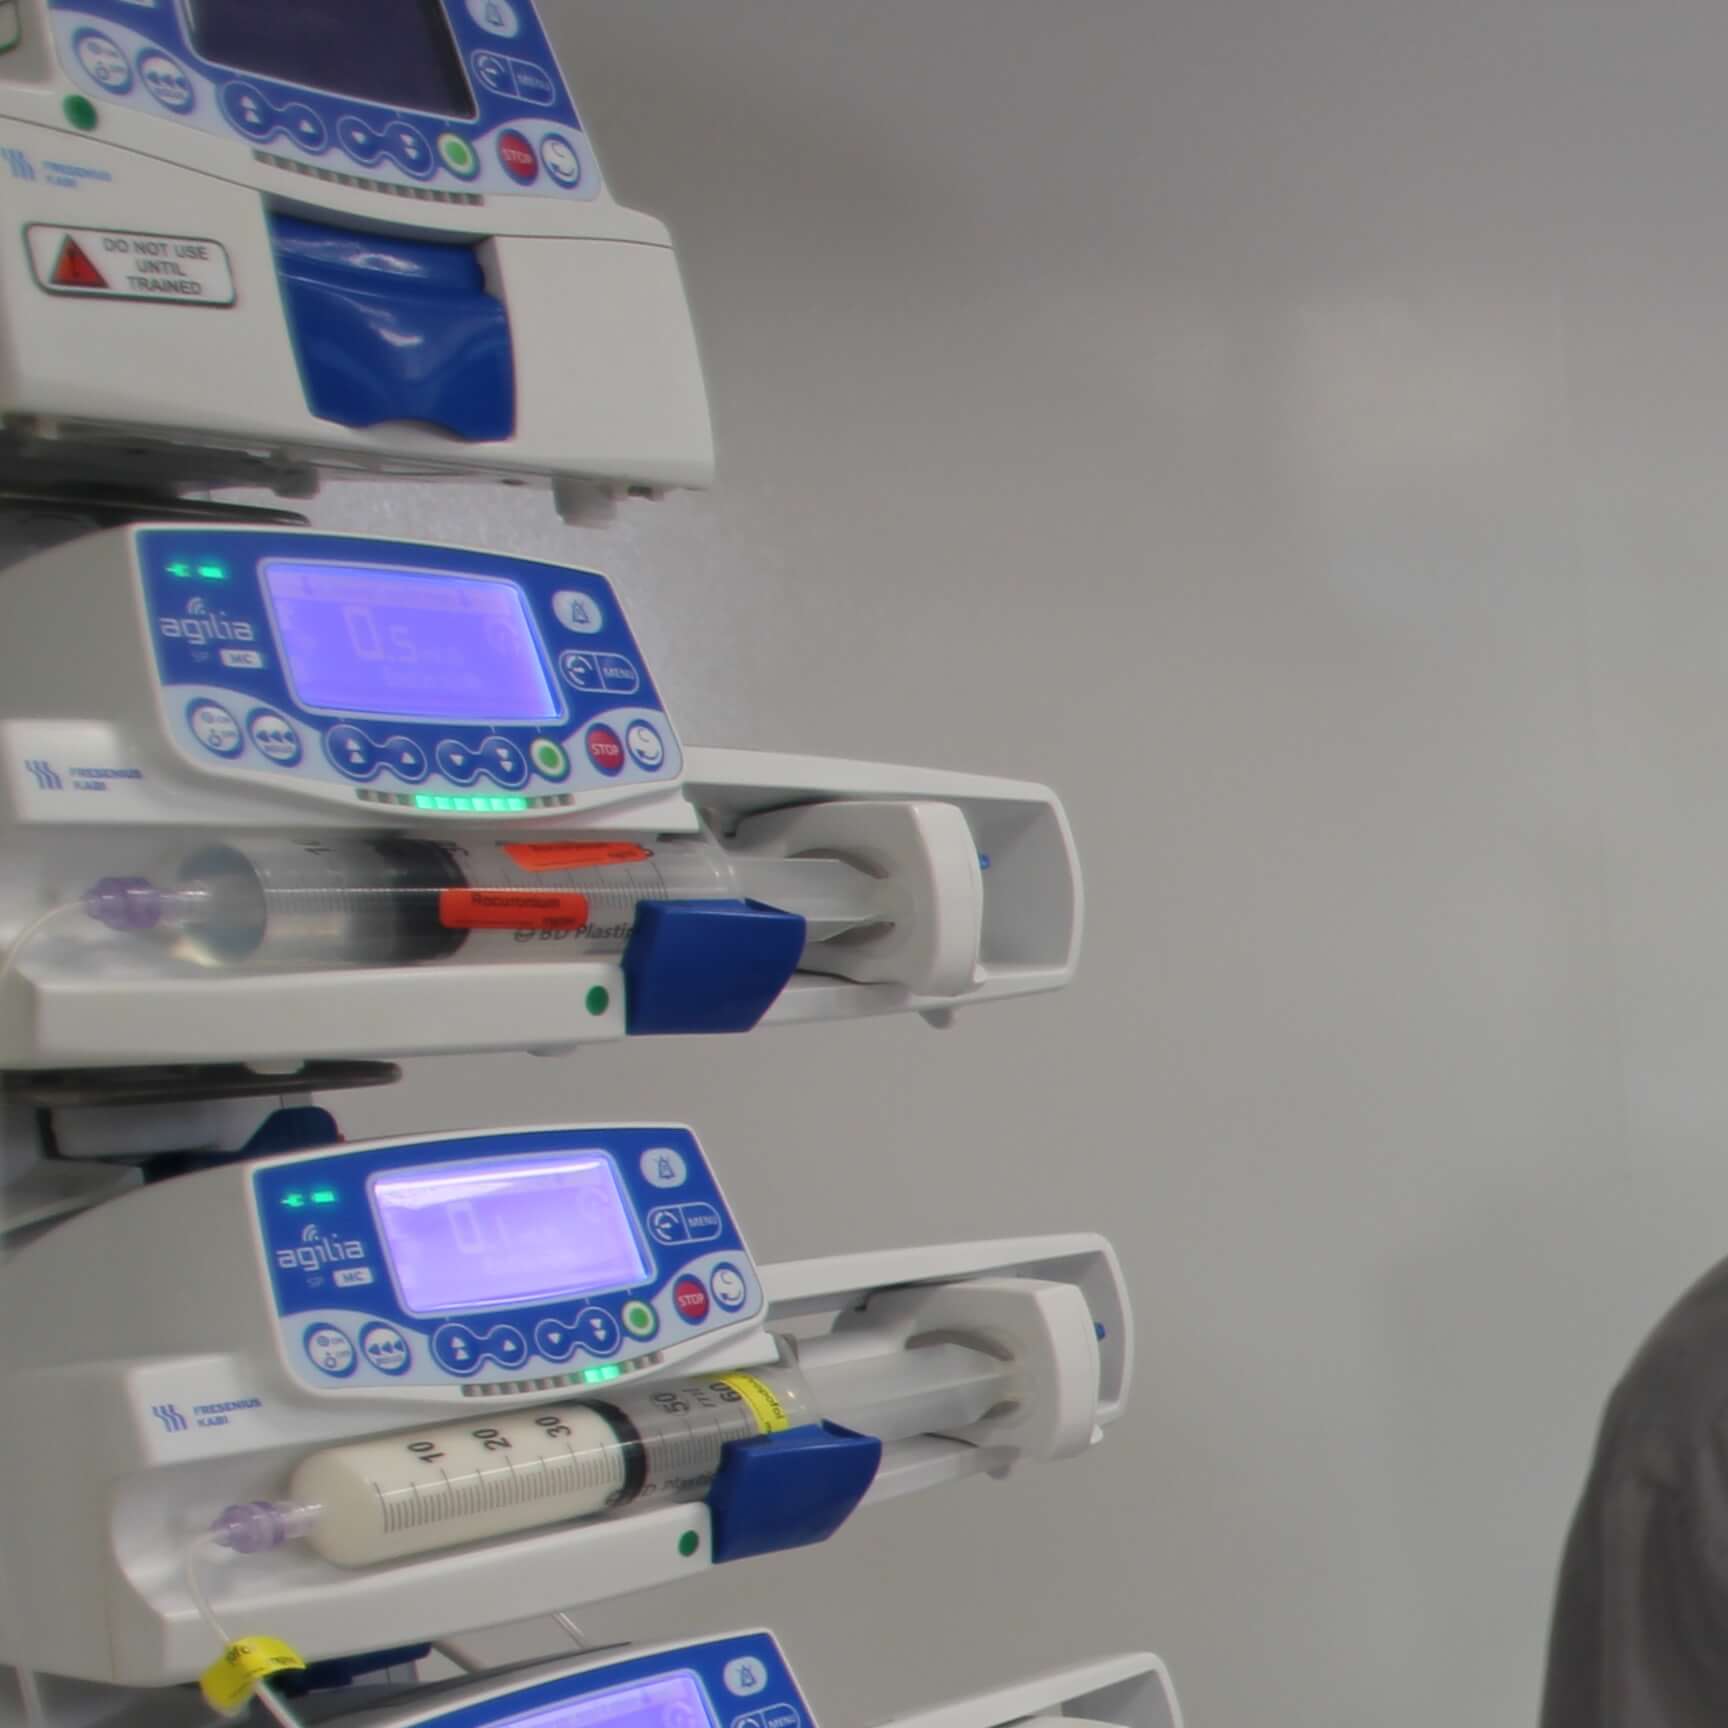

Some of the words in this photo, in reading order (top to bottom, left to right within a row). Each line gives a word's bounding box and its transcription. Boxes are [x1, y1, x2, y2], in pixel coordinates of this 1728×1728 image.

[503, 147, 533, 164] STOP
[102, 237, 130, 254] DO
[133, 240, 169, 257] NOT
[174, 244, 209, 261] USE
[135, 259, 188, 277] UNTIL
[125, 275, 204, 296] TRAINED
[160, 609, 254, 645] agilia
[591, 744, 620, 757] STOP
[686, 1215, 721, 1228] MENU
[275, 1233, 366, 1272] agilia
[677, 1292, 706, 1308] STOP
[652, 1391, 690, 1417] 50
[709, 1381, 744, 1405] 60
[193, 1398, 263, 1416] FRESENIUS
[197, 1415, 230, 1428] KABI
[534, 1415, 574, 1439] 30
[471, 1427, 514, 1452] 20
[406, 1440, 446, 1465] 10
